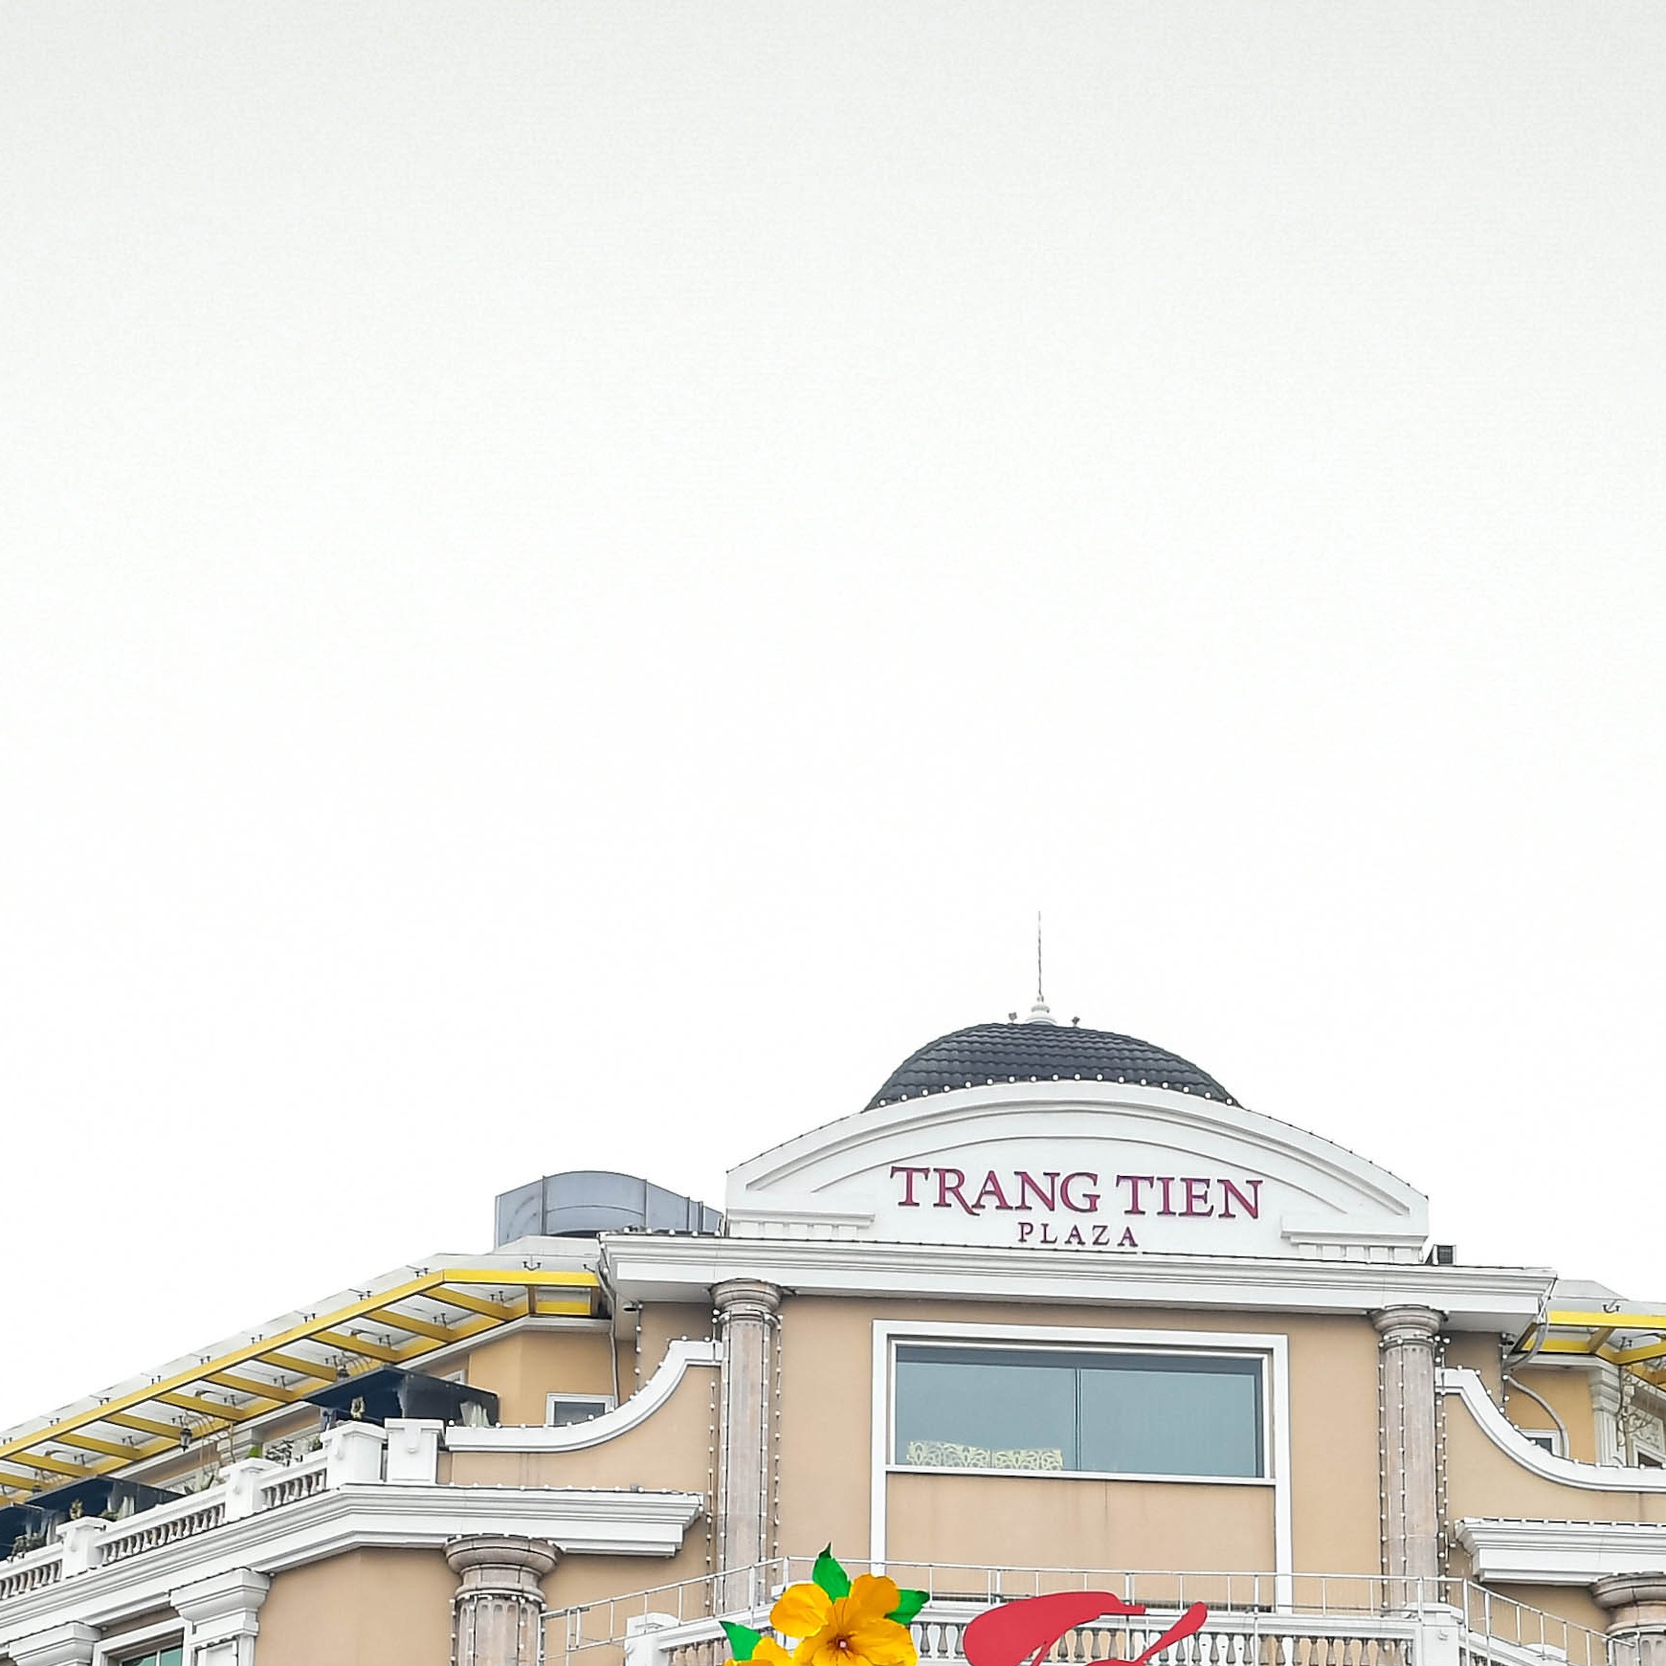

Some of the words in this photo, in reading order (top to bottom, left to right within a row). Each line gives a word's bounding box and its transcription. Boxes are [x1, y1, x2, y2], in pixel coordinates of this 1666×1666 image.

[890, 1165, 1101, 1217] TRANG
[1116, 1174, 1264, 1220] TIEN
[1018, 1222, 1139, 1247] PLAZA
